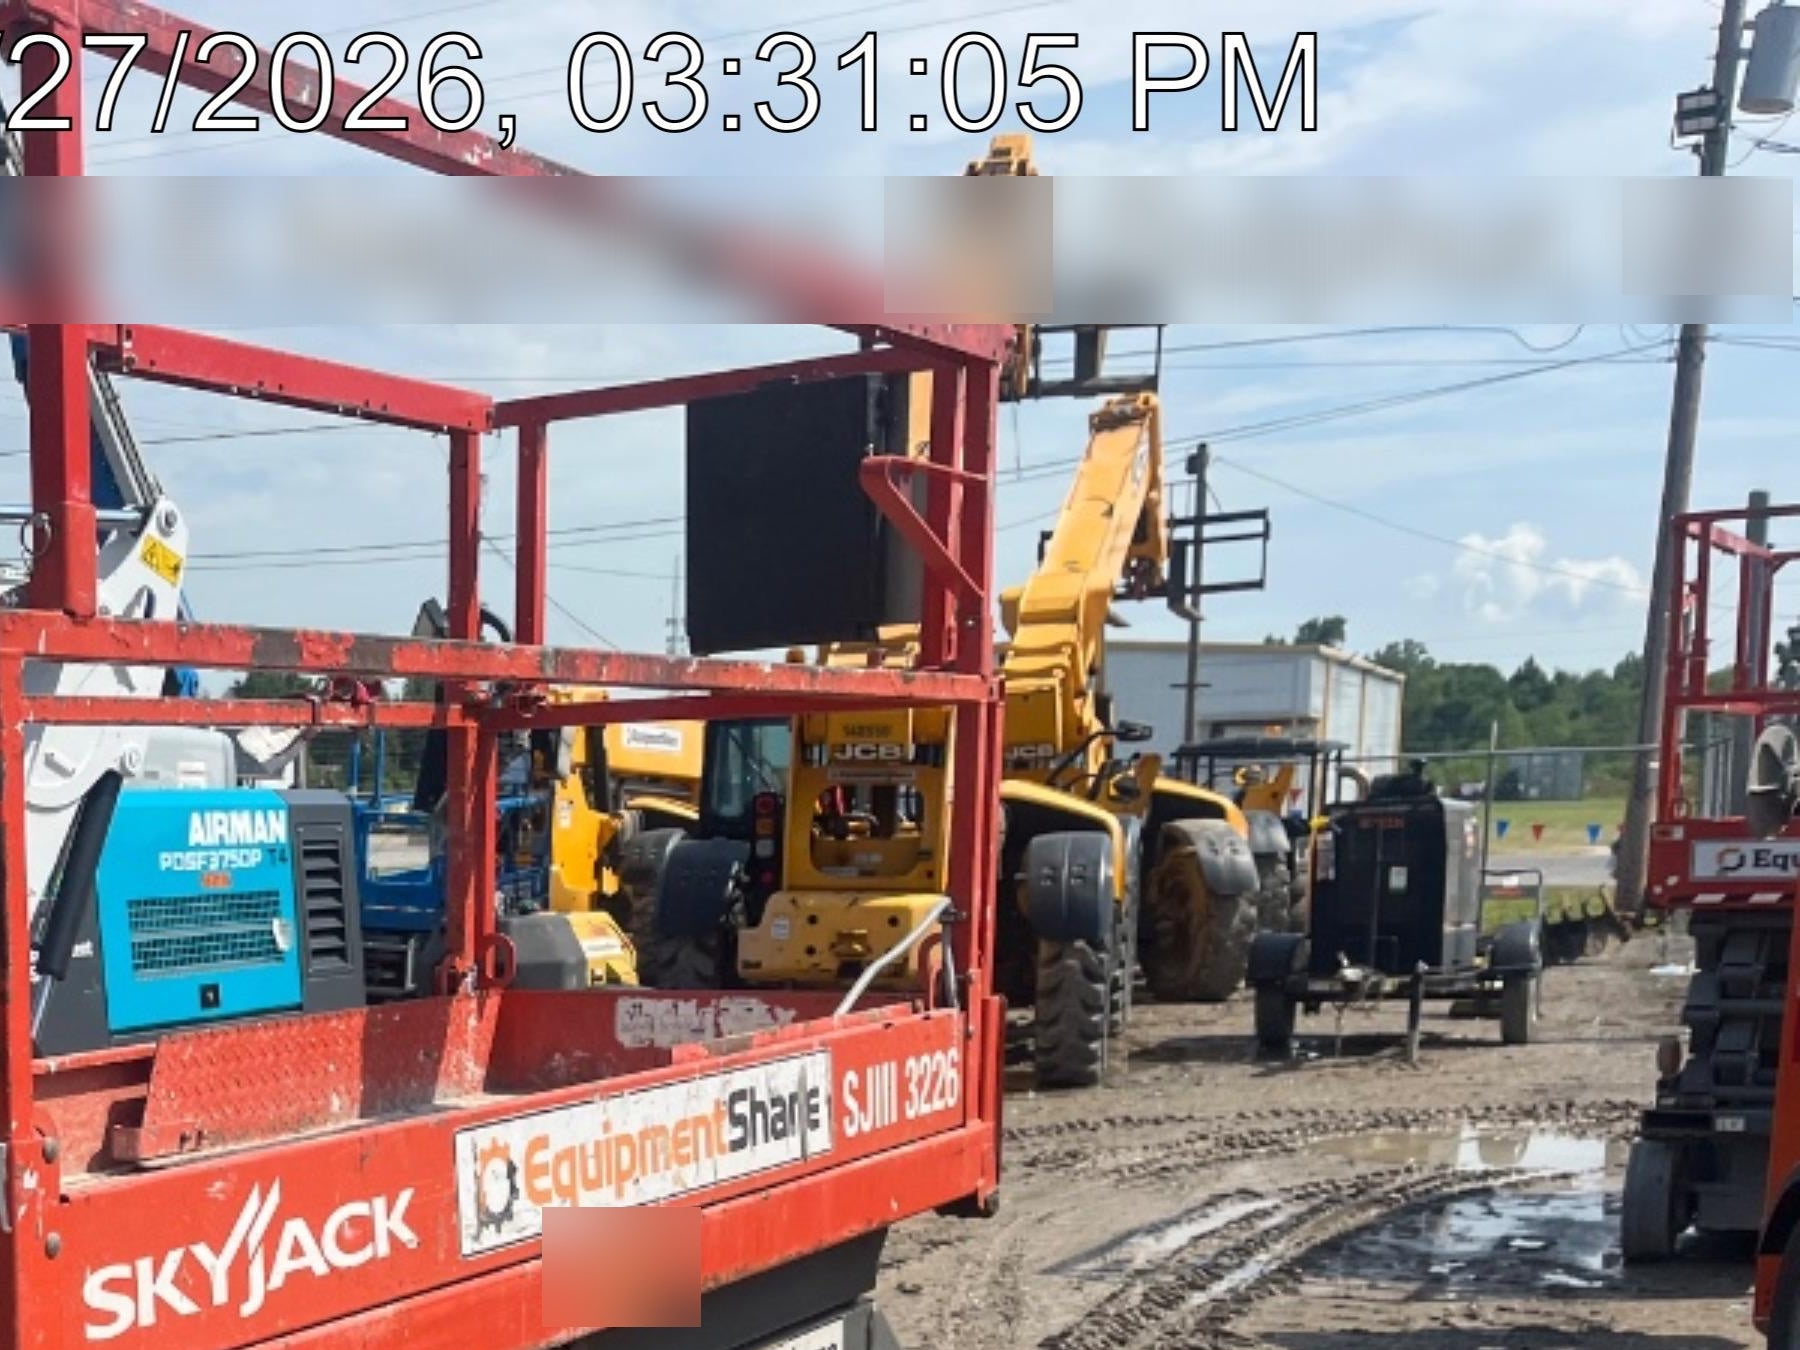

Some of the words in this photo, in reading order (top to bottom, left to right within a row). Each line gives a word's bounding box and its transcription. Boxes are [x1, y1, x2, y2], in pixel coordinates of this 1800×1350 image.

[833, 744, 903, 760] JCB
[188, 809, 287, 847] AIRMAN
[904, 1047, 959, 1119] 3226
[82, 1177, 420, 1340] SKYJACK
